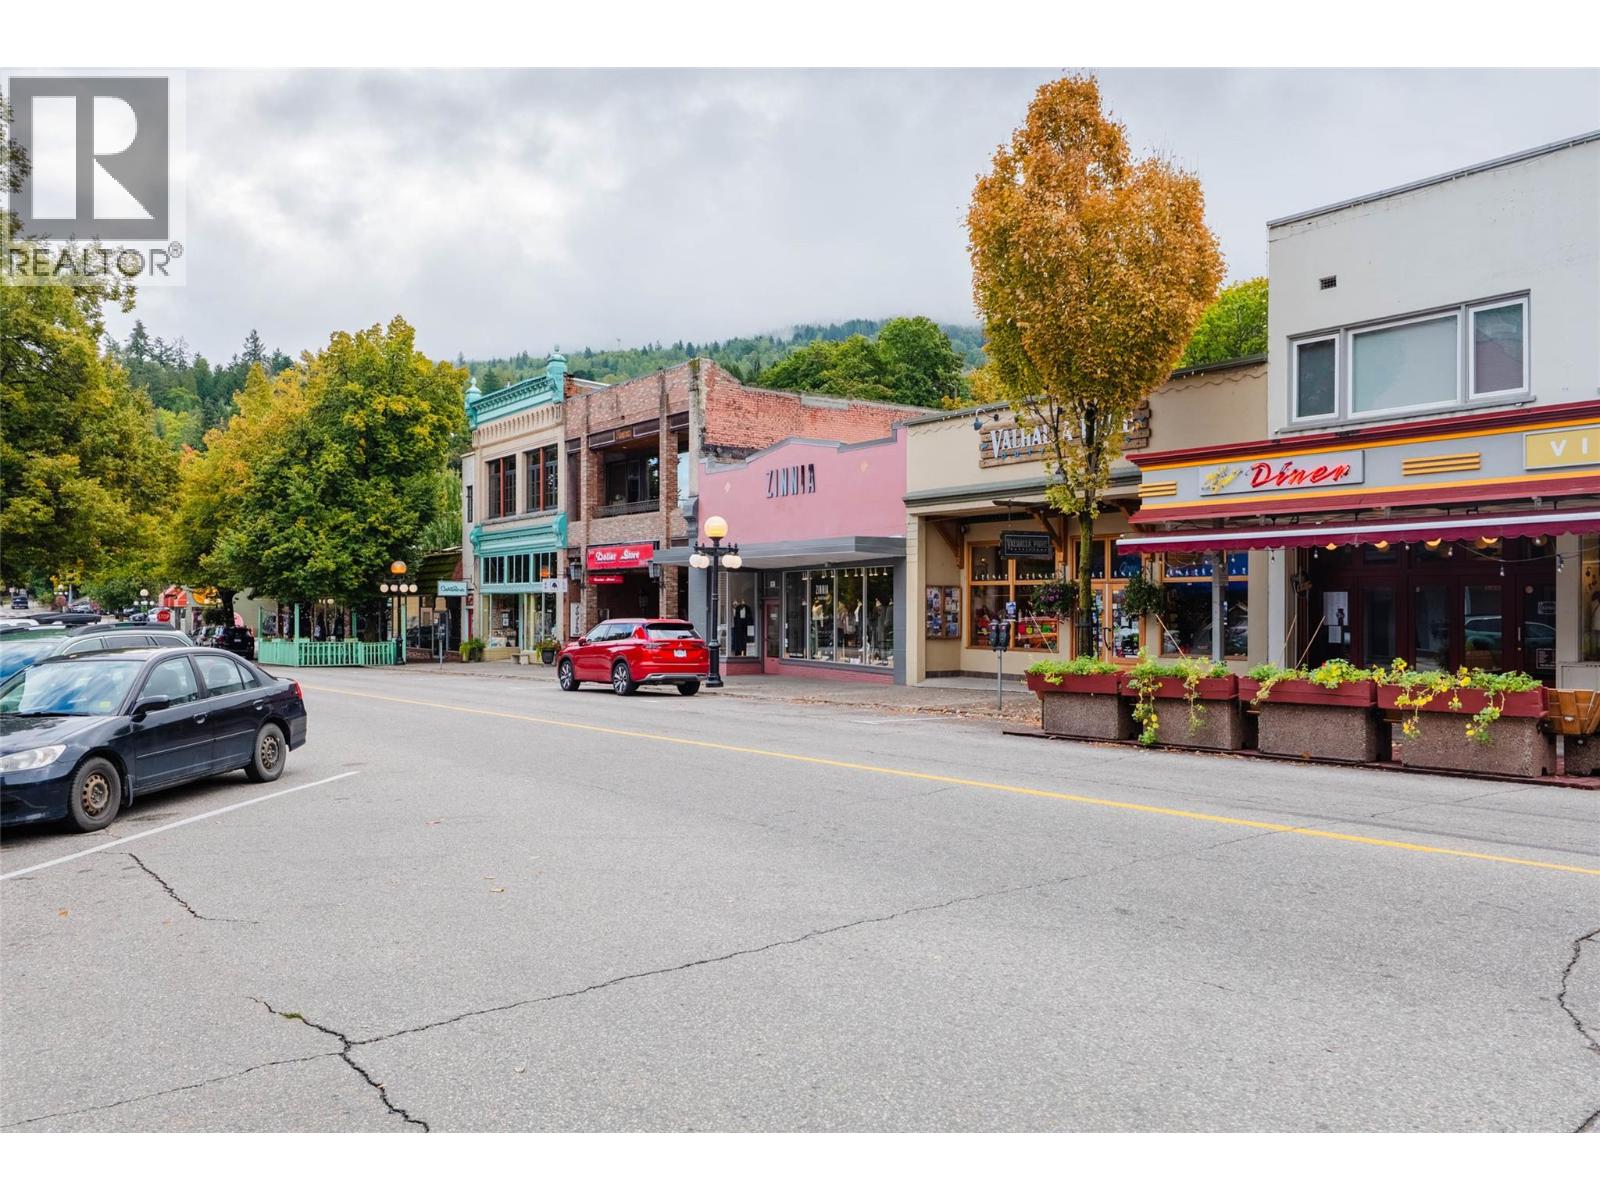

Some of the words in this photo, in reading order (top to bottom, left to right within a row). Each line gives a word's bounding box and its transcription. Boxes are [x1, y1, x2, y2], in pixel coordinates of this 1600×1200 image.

[766, 463, 816, 499] ZINNIA
[1249, 461, 1351, 488] Diner
[595, 551, 617, 561] Dollar
[620, 549, 640, 560] Store
